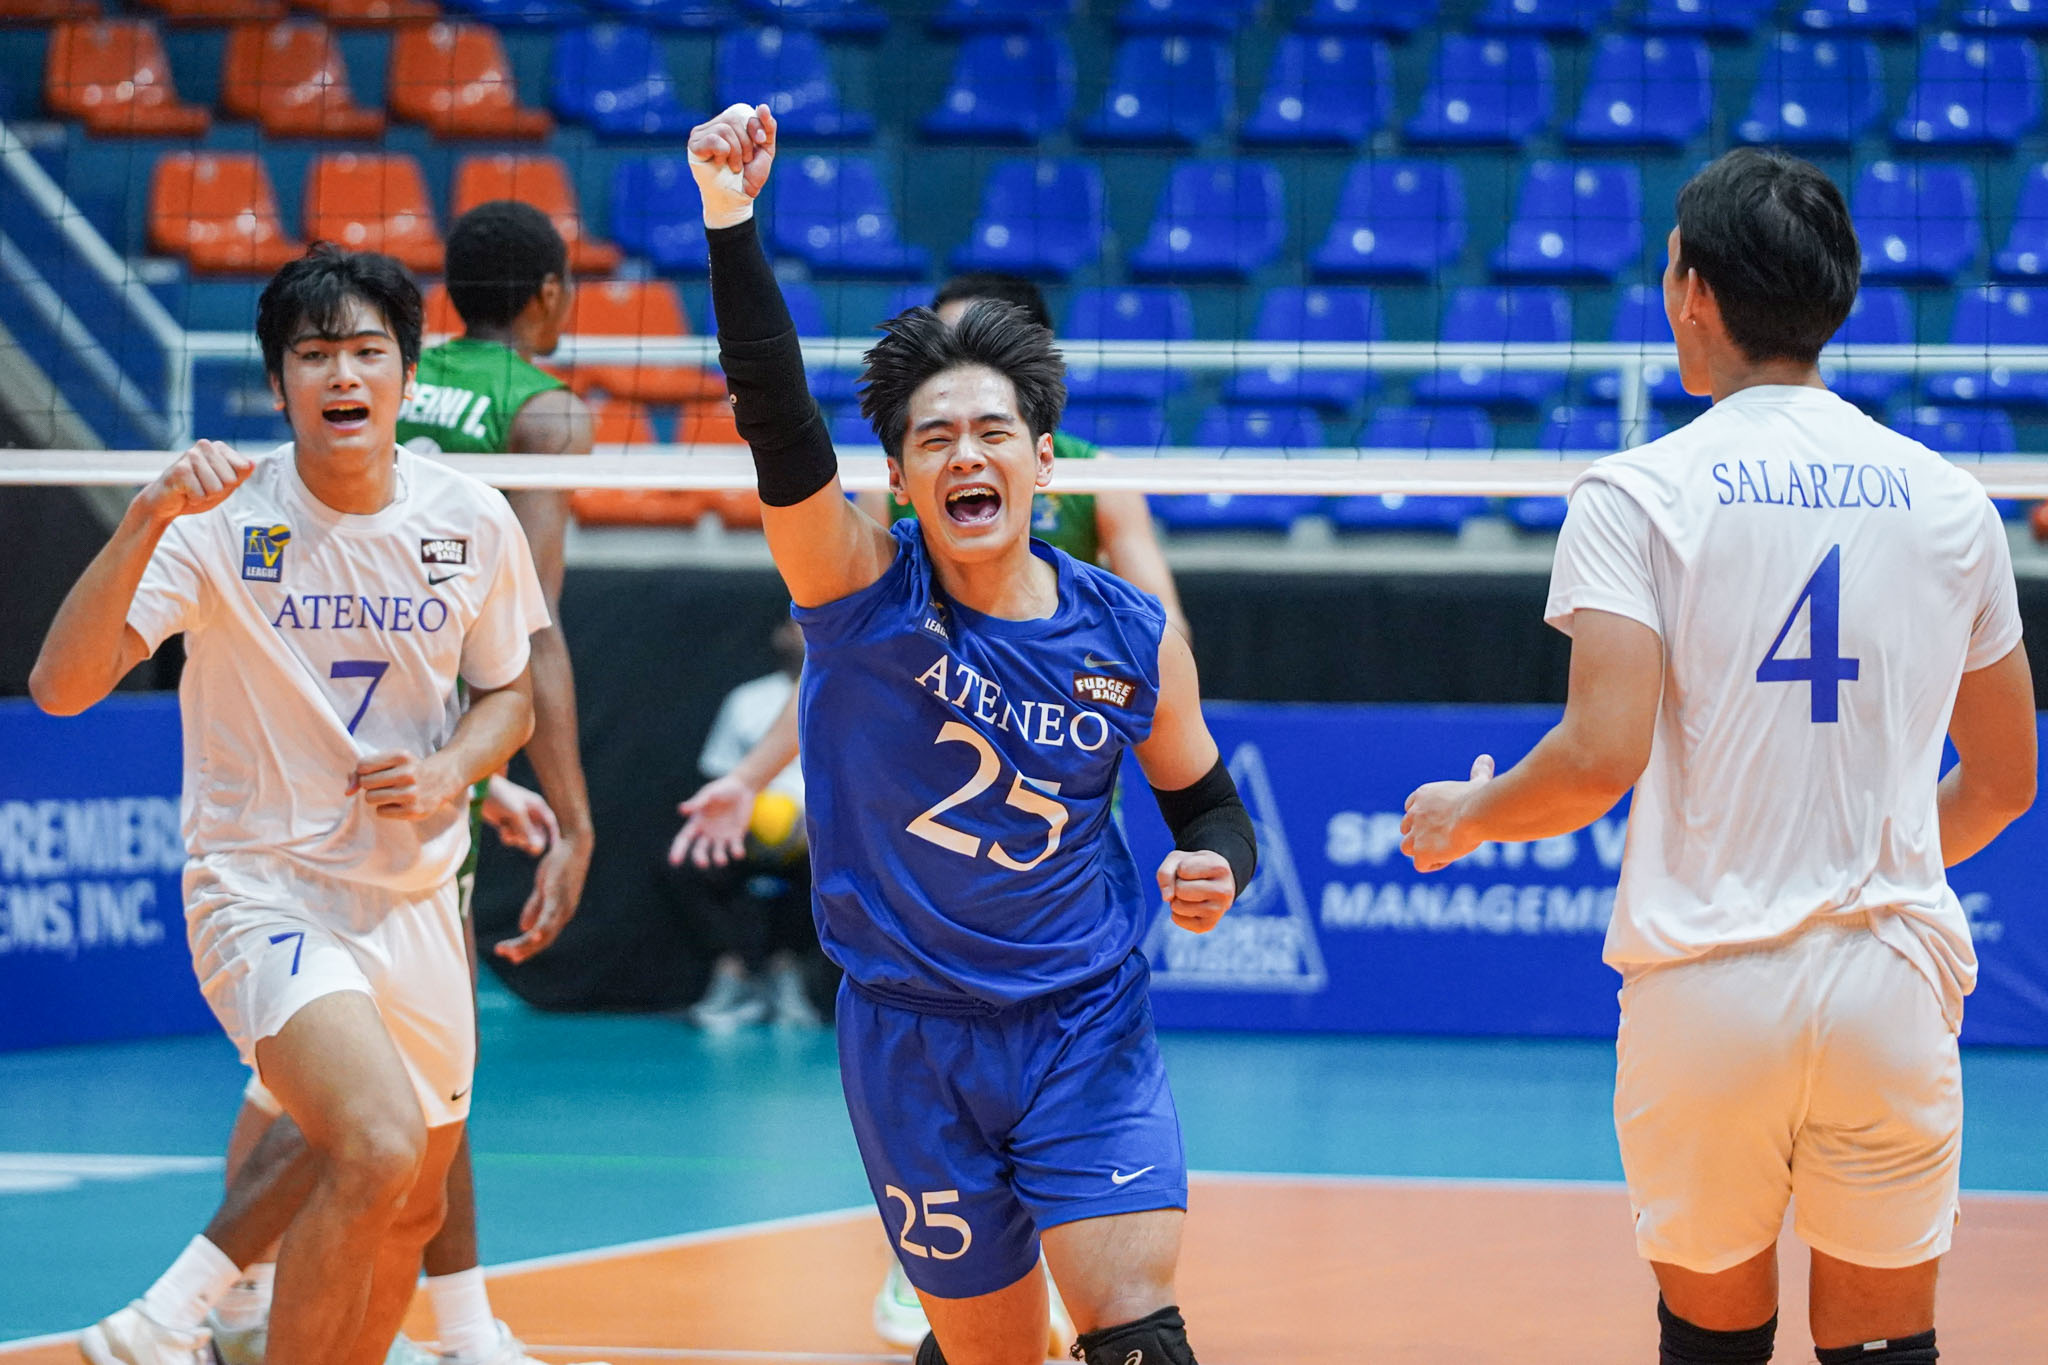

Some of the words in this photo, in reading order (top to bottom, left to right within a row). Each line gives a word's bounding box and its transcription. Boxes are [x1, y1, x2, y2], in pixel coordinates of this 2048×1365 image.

[1712, 459, 1911, 511] SALARZON
[246, 566, 279, 579] LEAGUE
[423, 541, 464, 557] FUDGEE
[271, 594, 449, 633] ATENEO
[1756, 543, 1860, 723] 4
[330, 659, 390, 737] 7
[914, 654, 1109, 751] ATENEO
[1075, 676, 1132, 697] FUDGEE
[1092, 688, 1126, 707] BARR
[905, 720, 1070, 873] 25
[268, 931, 305, 977] 7
[885, 1183, 973, 1261] 25
